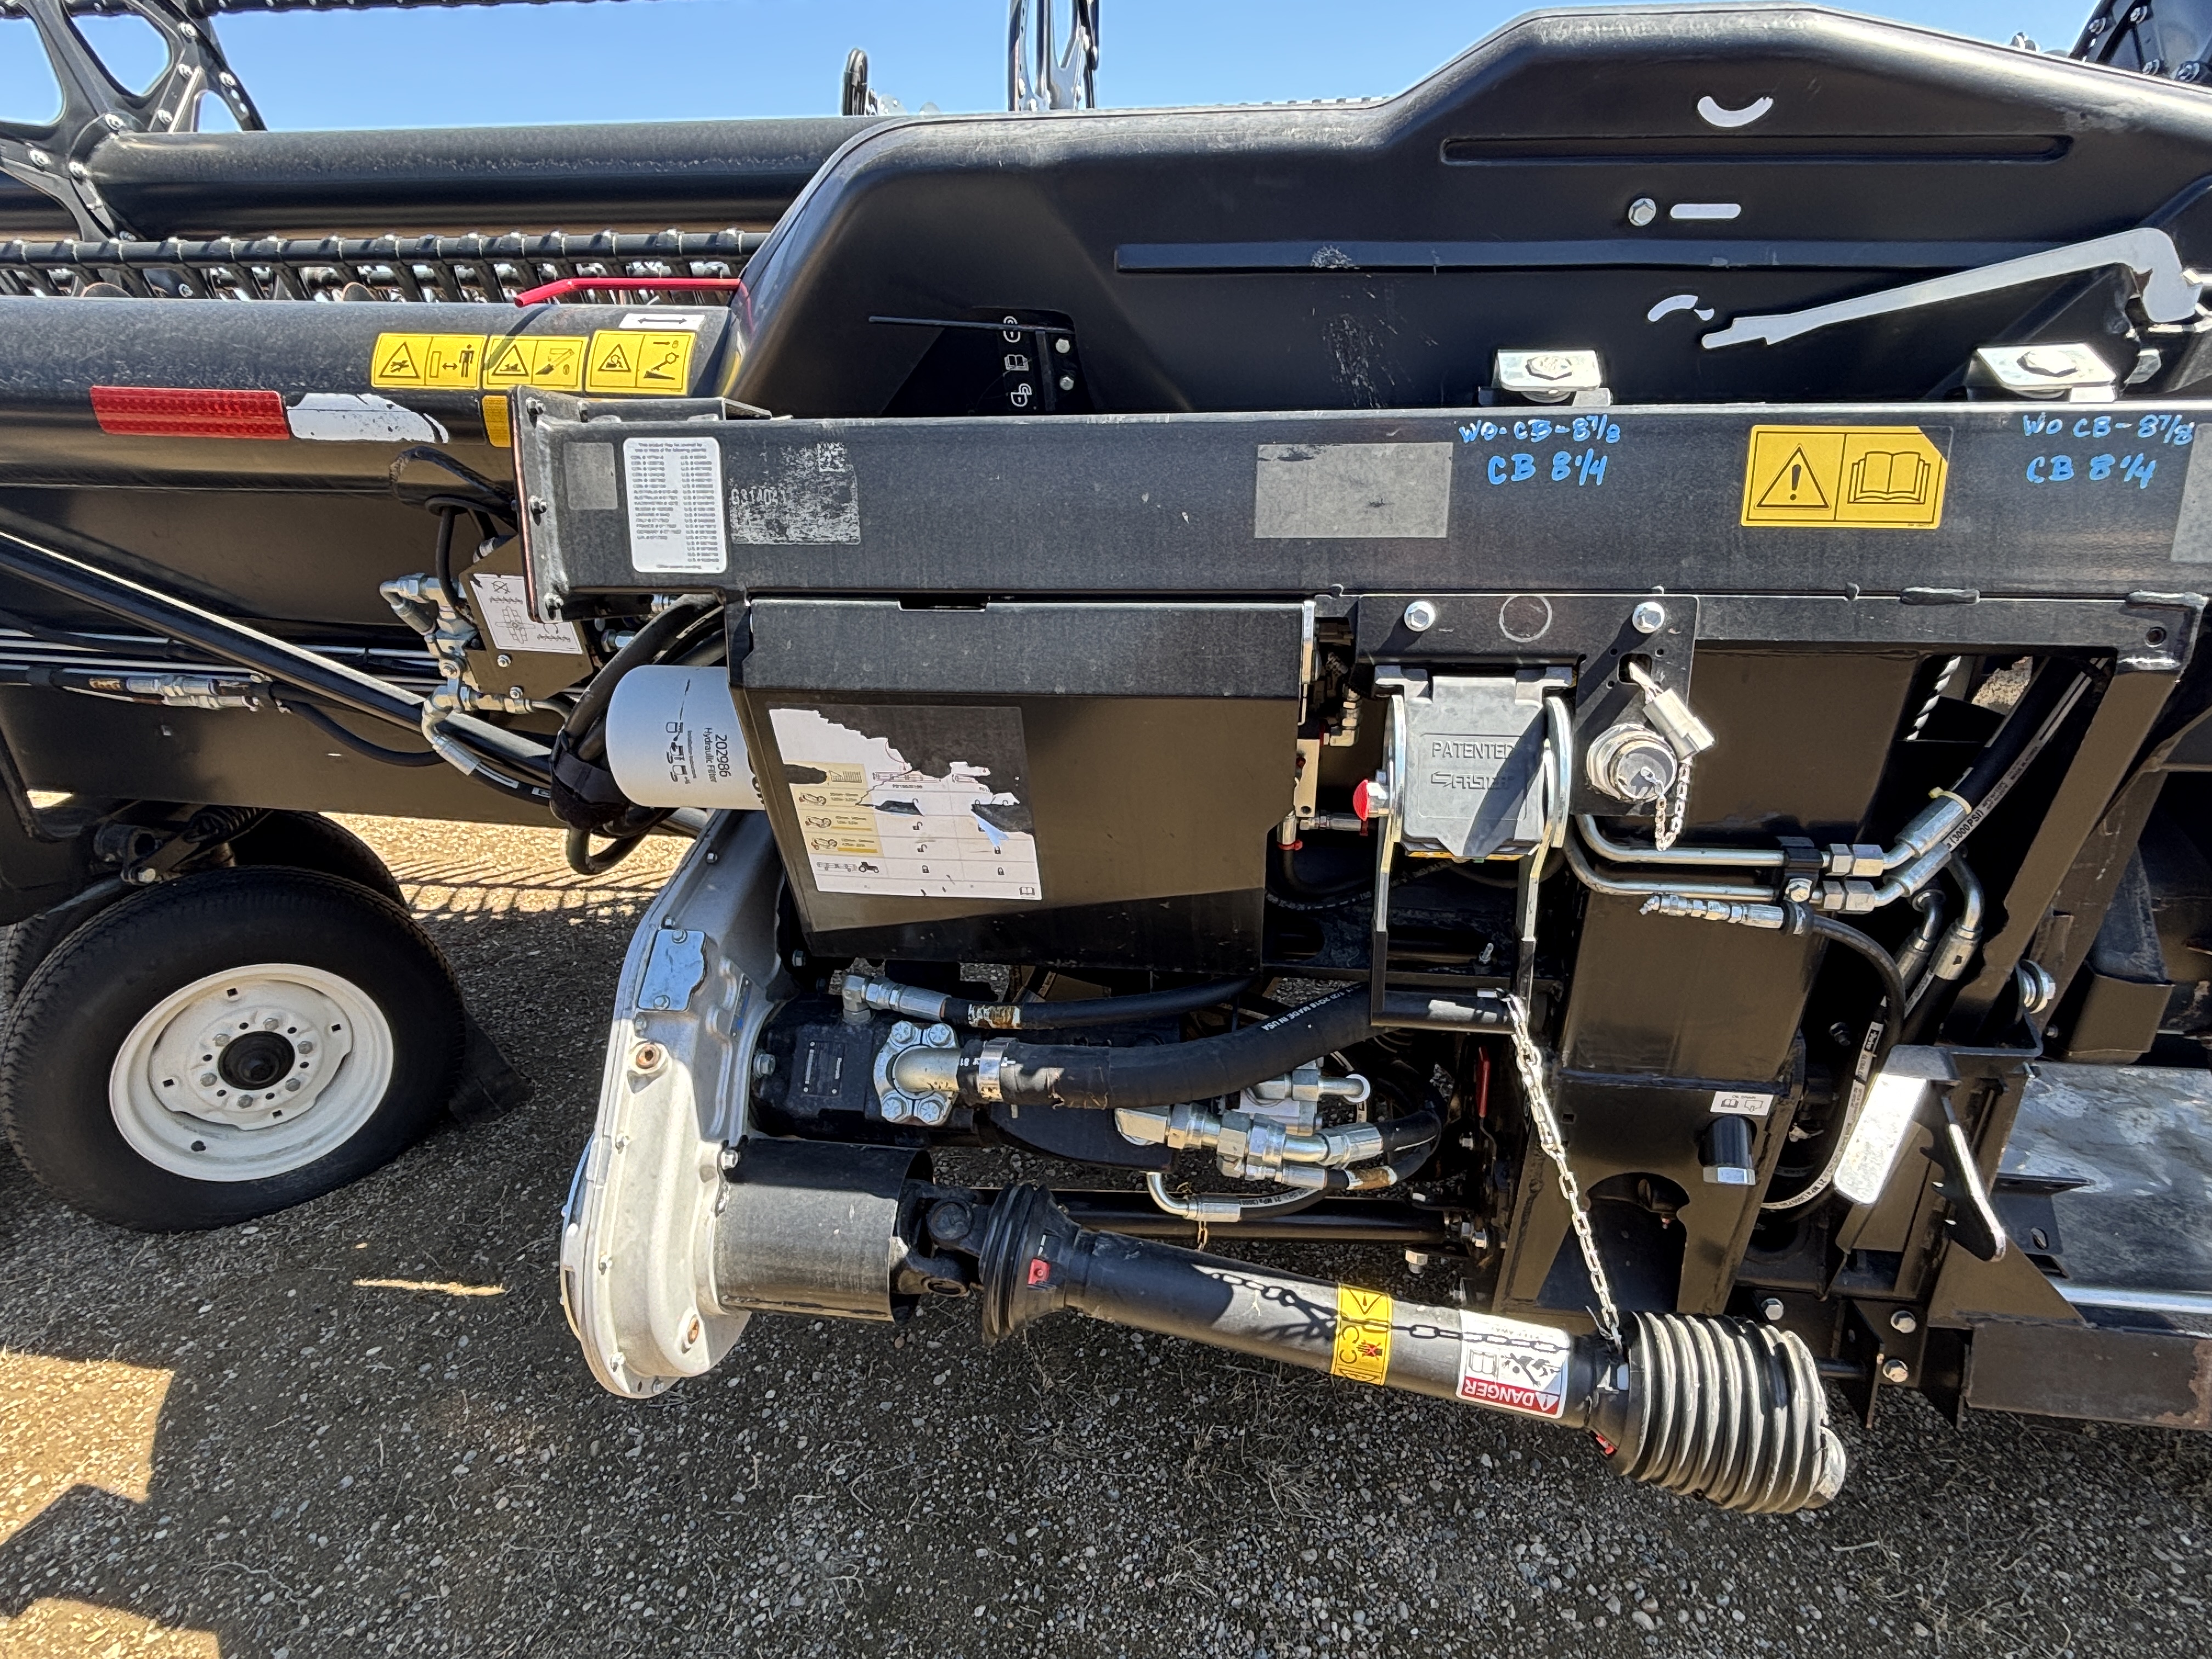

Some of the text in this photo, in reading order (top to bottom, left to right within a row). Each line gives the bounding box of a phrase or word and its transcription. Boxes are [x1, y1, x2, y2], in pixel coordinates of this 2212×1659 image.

[1488, 456, 1536, 485] CB
[2026, 455, 2074, 484] CB
[702, 727, 713, 764] Hydraulic
[715, 734, 732, 777] 202986
[1431, 741, 1516, 759] PATENTED
[1261, 1018, 1280, 1031] USA
[1278, 1016, 1289, 1025] IN
[1288, 1006, 1311, 1020] MADE
[1465, 1379, 1536, 1407] DANGER
